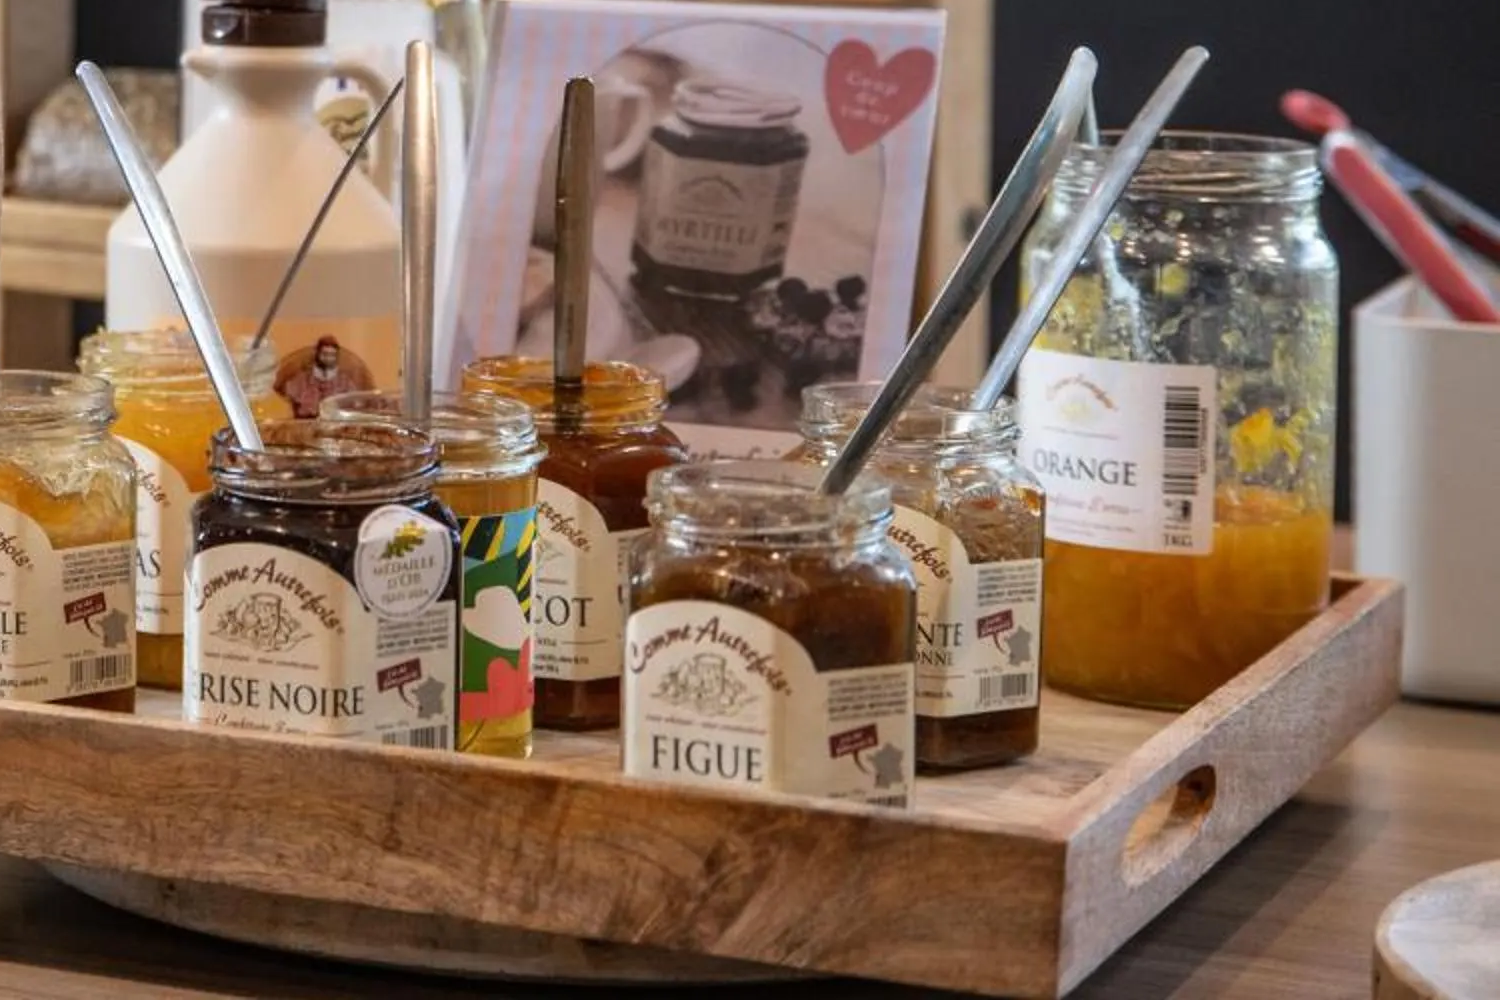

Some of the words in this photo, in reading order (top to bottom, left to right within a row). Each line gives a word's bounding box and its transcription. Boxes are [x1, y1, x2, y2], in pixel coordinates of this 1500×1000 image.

[1032, 448, 1138, 487] ORANGE
[887, 523, 950, 579] utrefois
[252, 557, 340, 630] Autrefois
[630, 624, 692, 674] Comme
[694, 616, 790, 692] Autrefois
[192, 671, 260, 708] RISE
[268, 681, 366, 719] NOIRE
[651, 734, 764, 782] FIGUE
